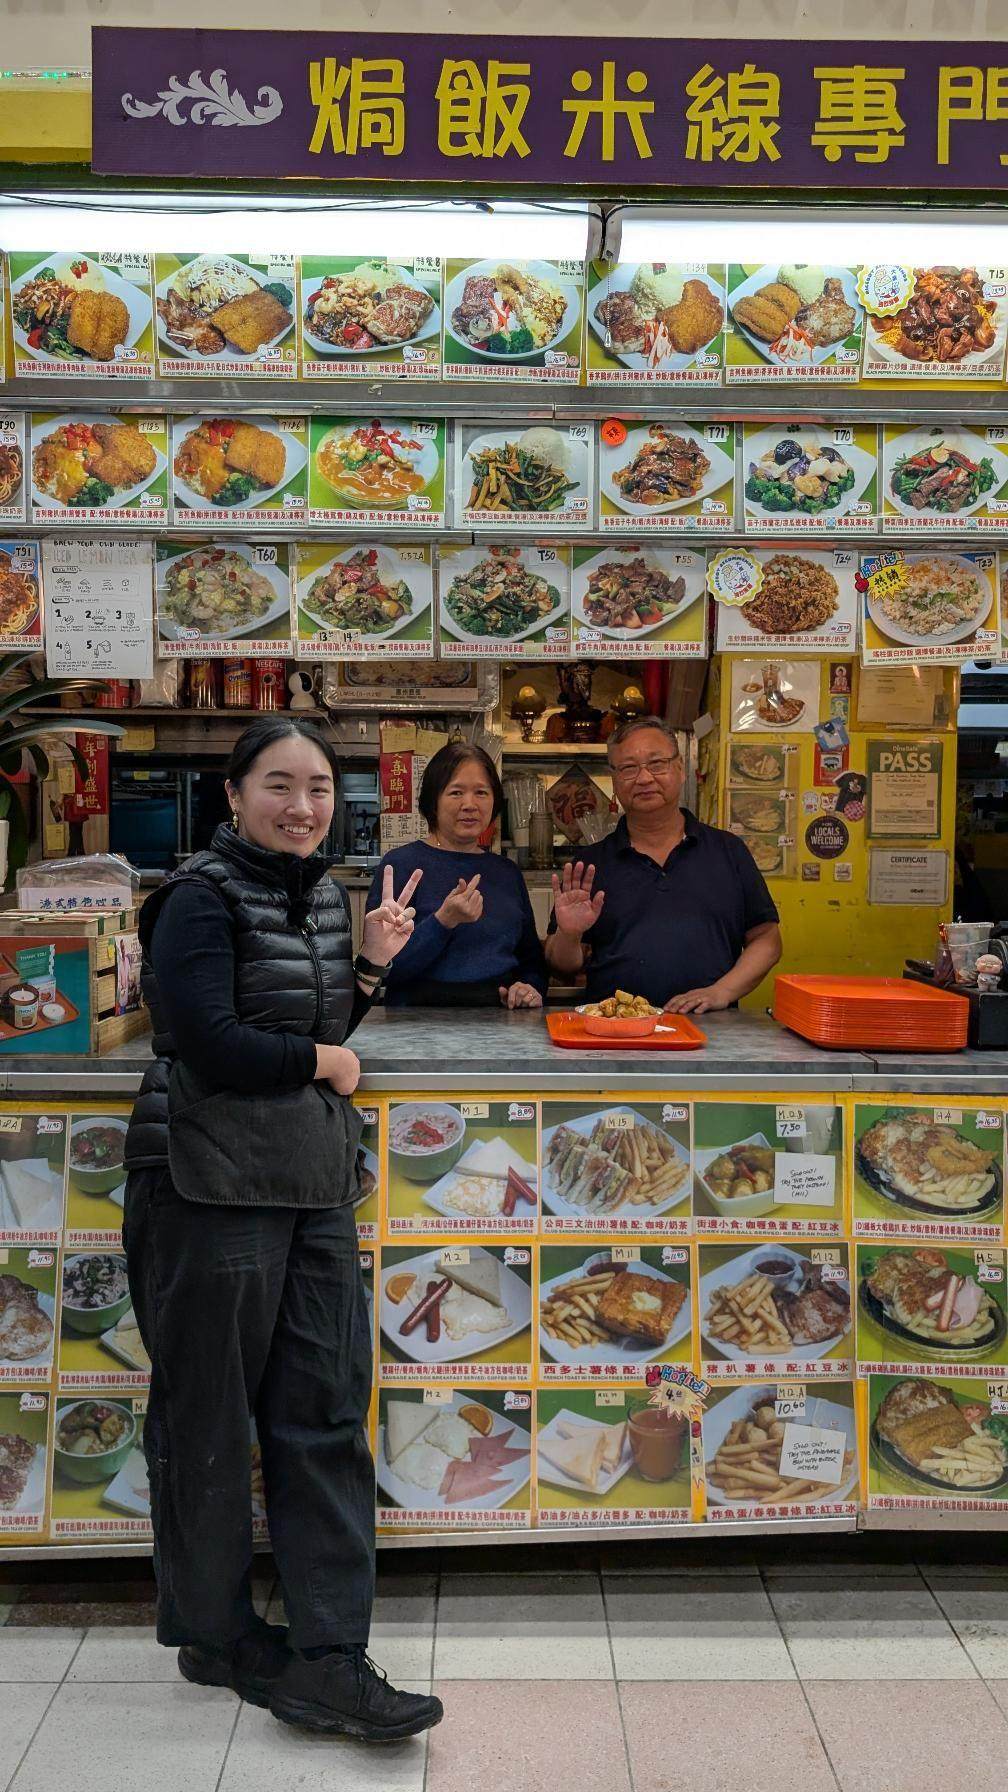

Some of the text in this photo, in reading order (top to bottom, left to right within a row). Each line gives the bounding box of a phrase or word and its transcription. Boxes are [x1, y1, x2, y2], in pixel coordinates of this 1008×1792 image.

[308, 57, 1008, 165] 焗飯米線專門
[989, 269, 1004, 280] T15
[571, 427, 587, 438] T69
[708, 427, 724, 439] T71
[835, 430, 851, 440] T70
[257, 549, 274, 561] T60
[538, 550, 555, 560] T50
[835, 554, 851, 564] T24
[55, 609, 62, 617] 1
[85, 610, 92, 619] 2
[115, 610, 122, 619] 3
[86, 640, 92, 650] 5
[880, 752, 932, 772] PASS
[815, 827, 840, 836] LOCALS
[811, 836, 844, 845] WELCOME
[779, 1122, 800, 1136] 7.50
[544, 1365, 618, 1375] 西多士薯條
